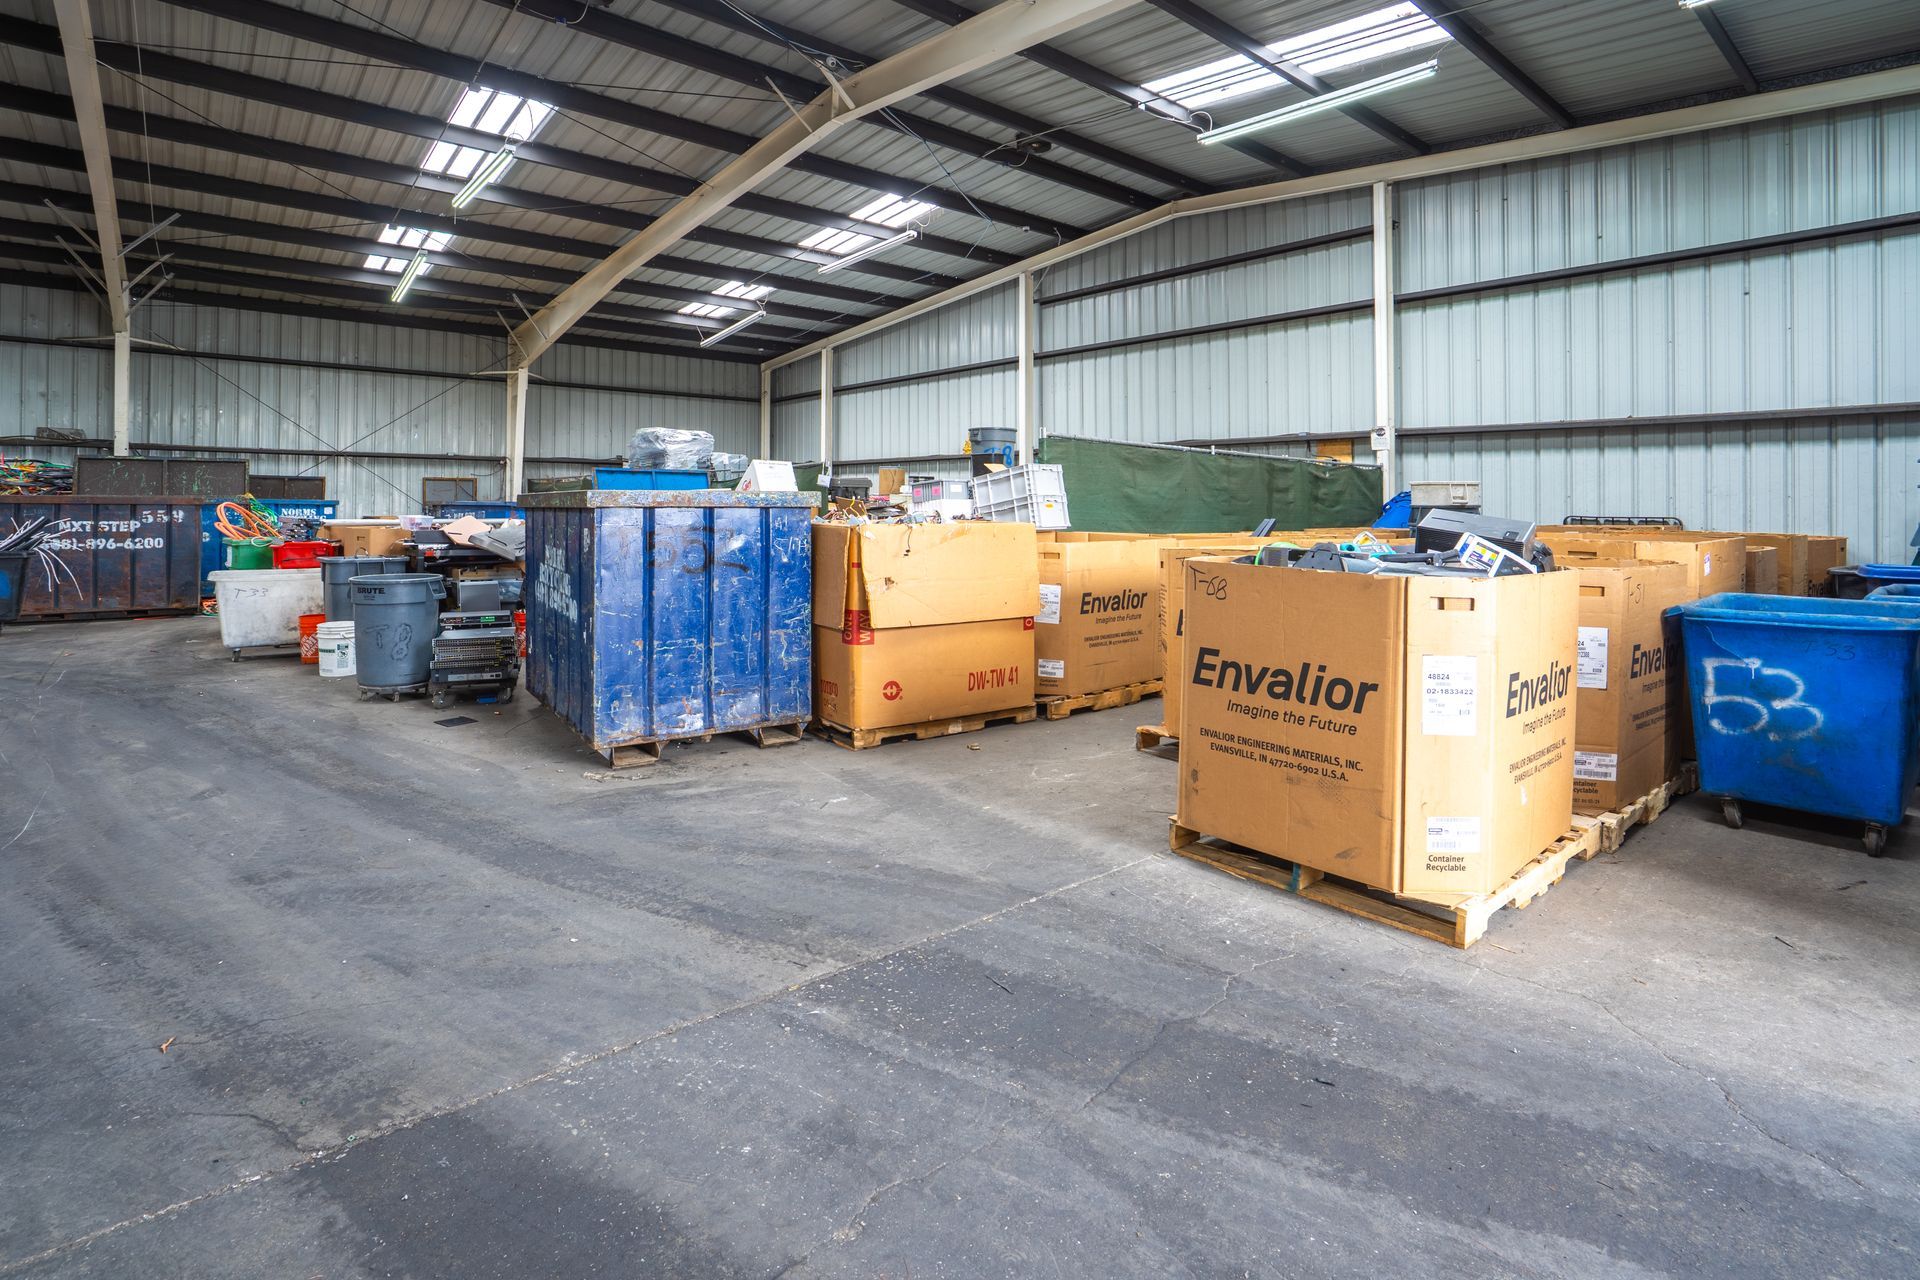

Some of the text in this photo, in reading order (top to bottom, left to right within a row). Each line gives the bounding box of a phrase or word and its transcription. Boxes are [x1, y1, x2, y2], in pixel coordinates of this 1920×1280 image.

[59, 520, 141, 532] NXT STEP
[281, 508, 316, 516] NORMS
[357, 587, 385, 595] BRUTE
[1189, 565, 1228, 600] T-68
[1080, 588, 1148, 615] Envalior
[844, 612, 853, 640] ONE
[860, 613, 871, 643] WAY
[1096, 616, 1116, 624] Imagine
[1126, 613, 1142, 621] Future
[968, 667, 1006, 692] DW-TW
[1008, 665, 1018, 686] 41
[1192, 646, 1379, 714] Envalior
[1506, 660, 1572, 719] Envalior
[1702, 657, 1824, 741] 53
[1227, 700, 1358, 736] Imagine the Future
[1522, 706, 1567, 735] Imagine the Future
[1200, 727, 1363, 772] ENVALIOR ENGINEERING MATERIALS, INC.
[1210, 742, 1349, 782] EVANSVILLE, IN 47720-6902 U.S.A.
[1572, 787, 1599, 795] cyclable
[1426, 863, 1467, 872] Recyclable
